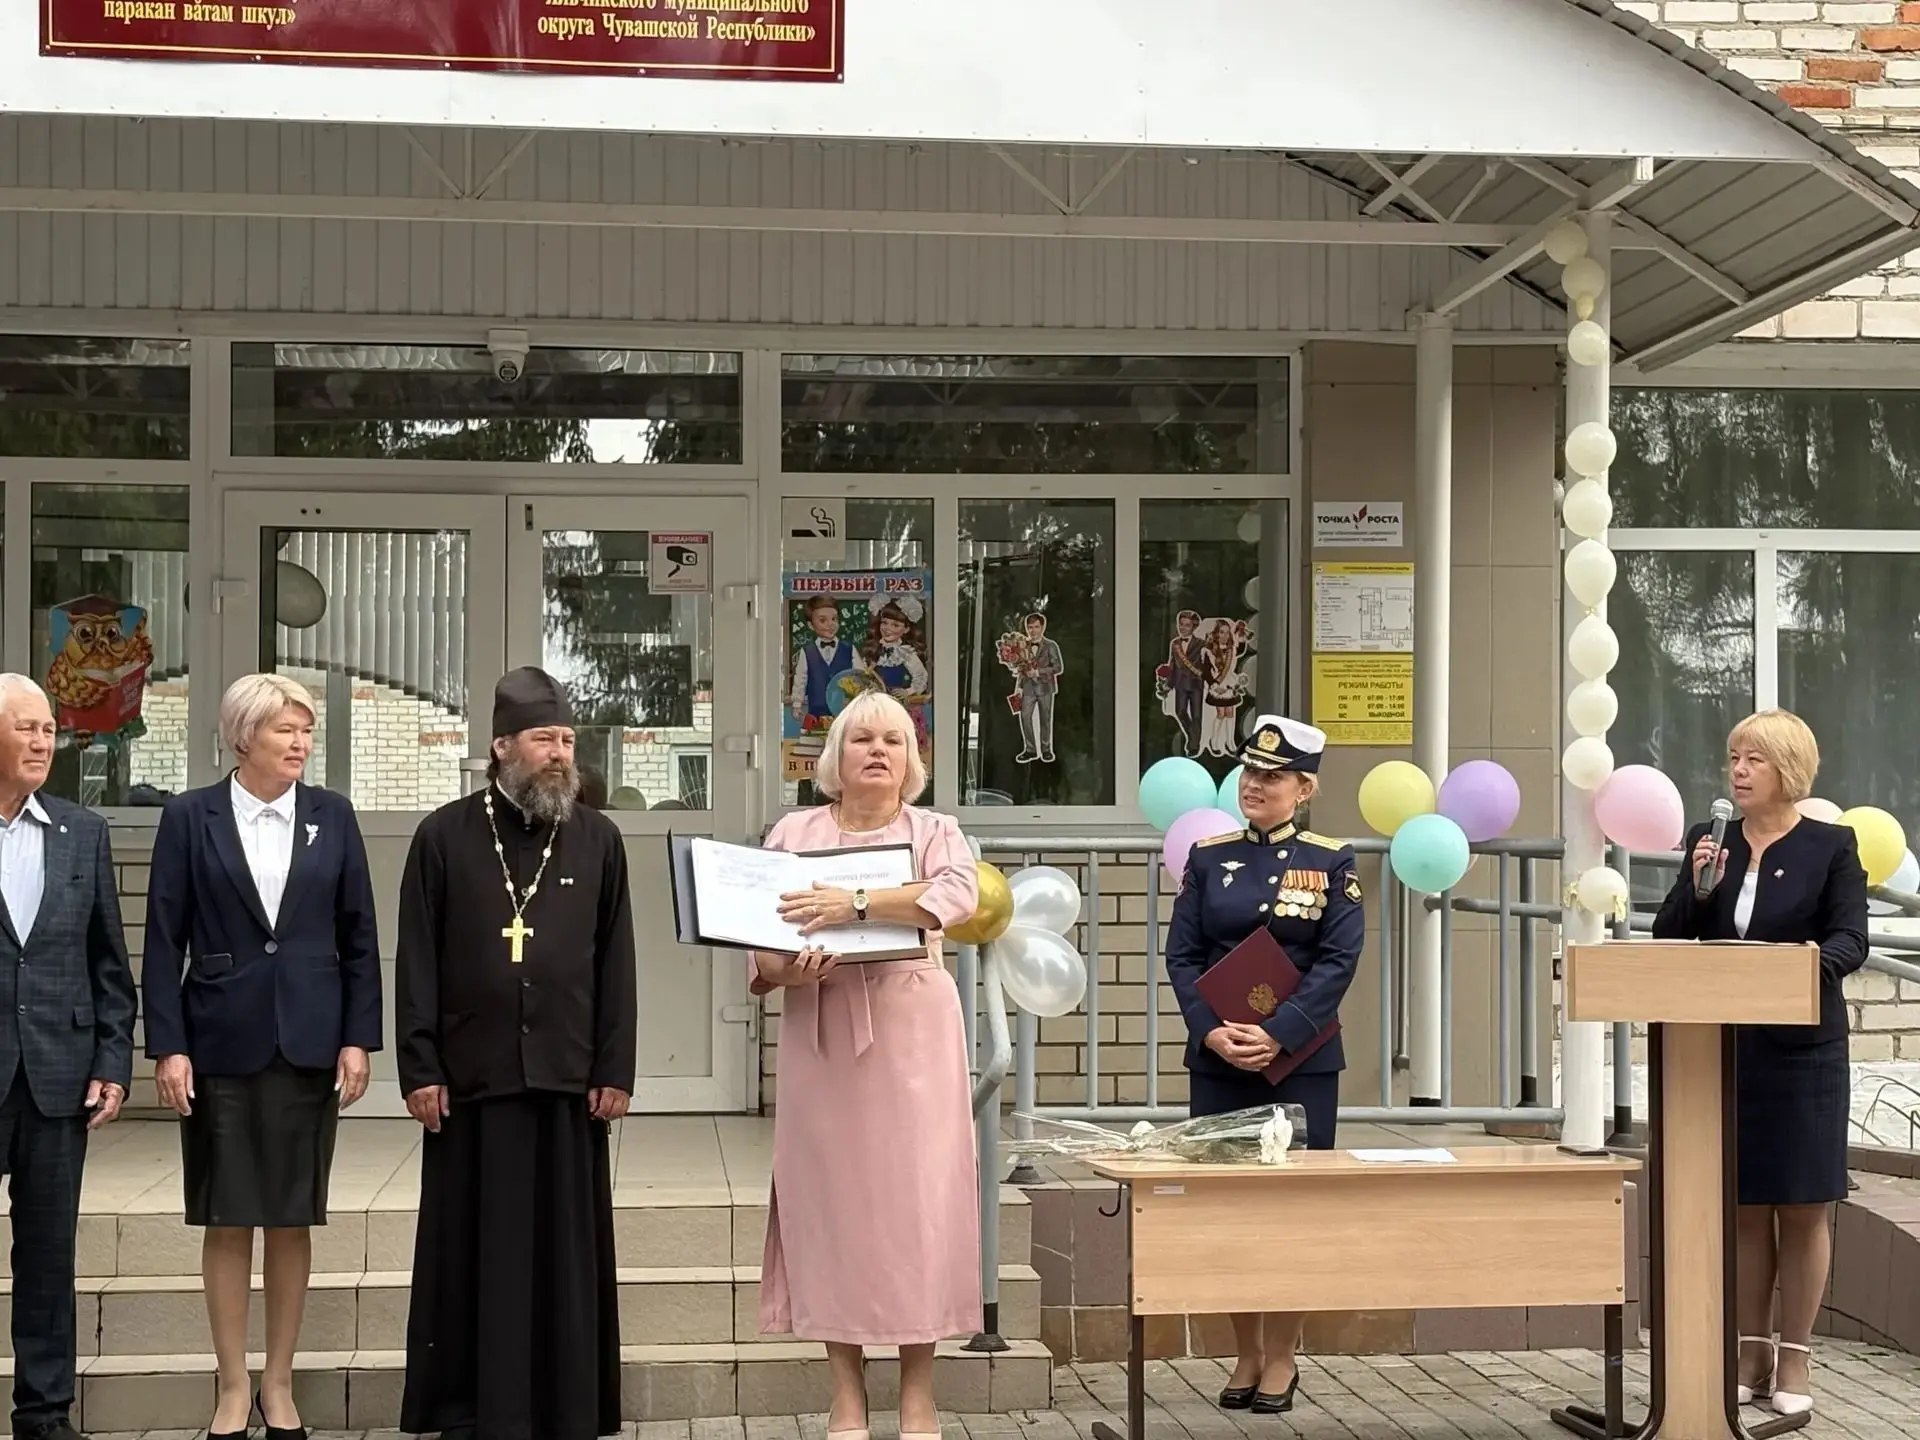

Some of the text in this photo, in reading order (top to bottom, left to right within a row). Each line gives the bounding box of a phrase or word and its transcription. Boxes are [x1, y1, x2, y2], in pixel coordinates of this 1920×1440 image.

[103, 0, 176, 25] паракан
[241, 6, 297, 31] шкул»
[537, 12, 816, 46] округа Чувашской Республики»
[1317, 515, 1399, 524] ТОЧКА РОСТА
[792, 575, 924, 593] ПЕРВЫЙ РАЗ
[1338, 681, 1404, 689] РЕЖИМ РАБОТЫ
